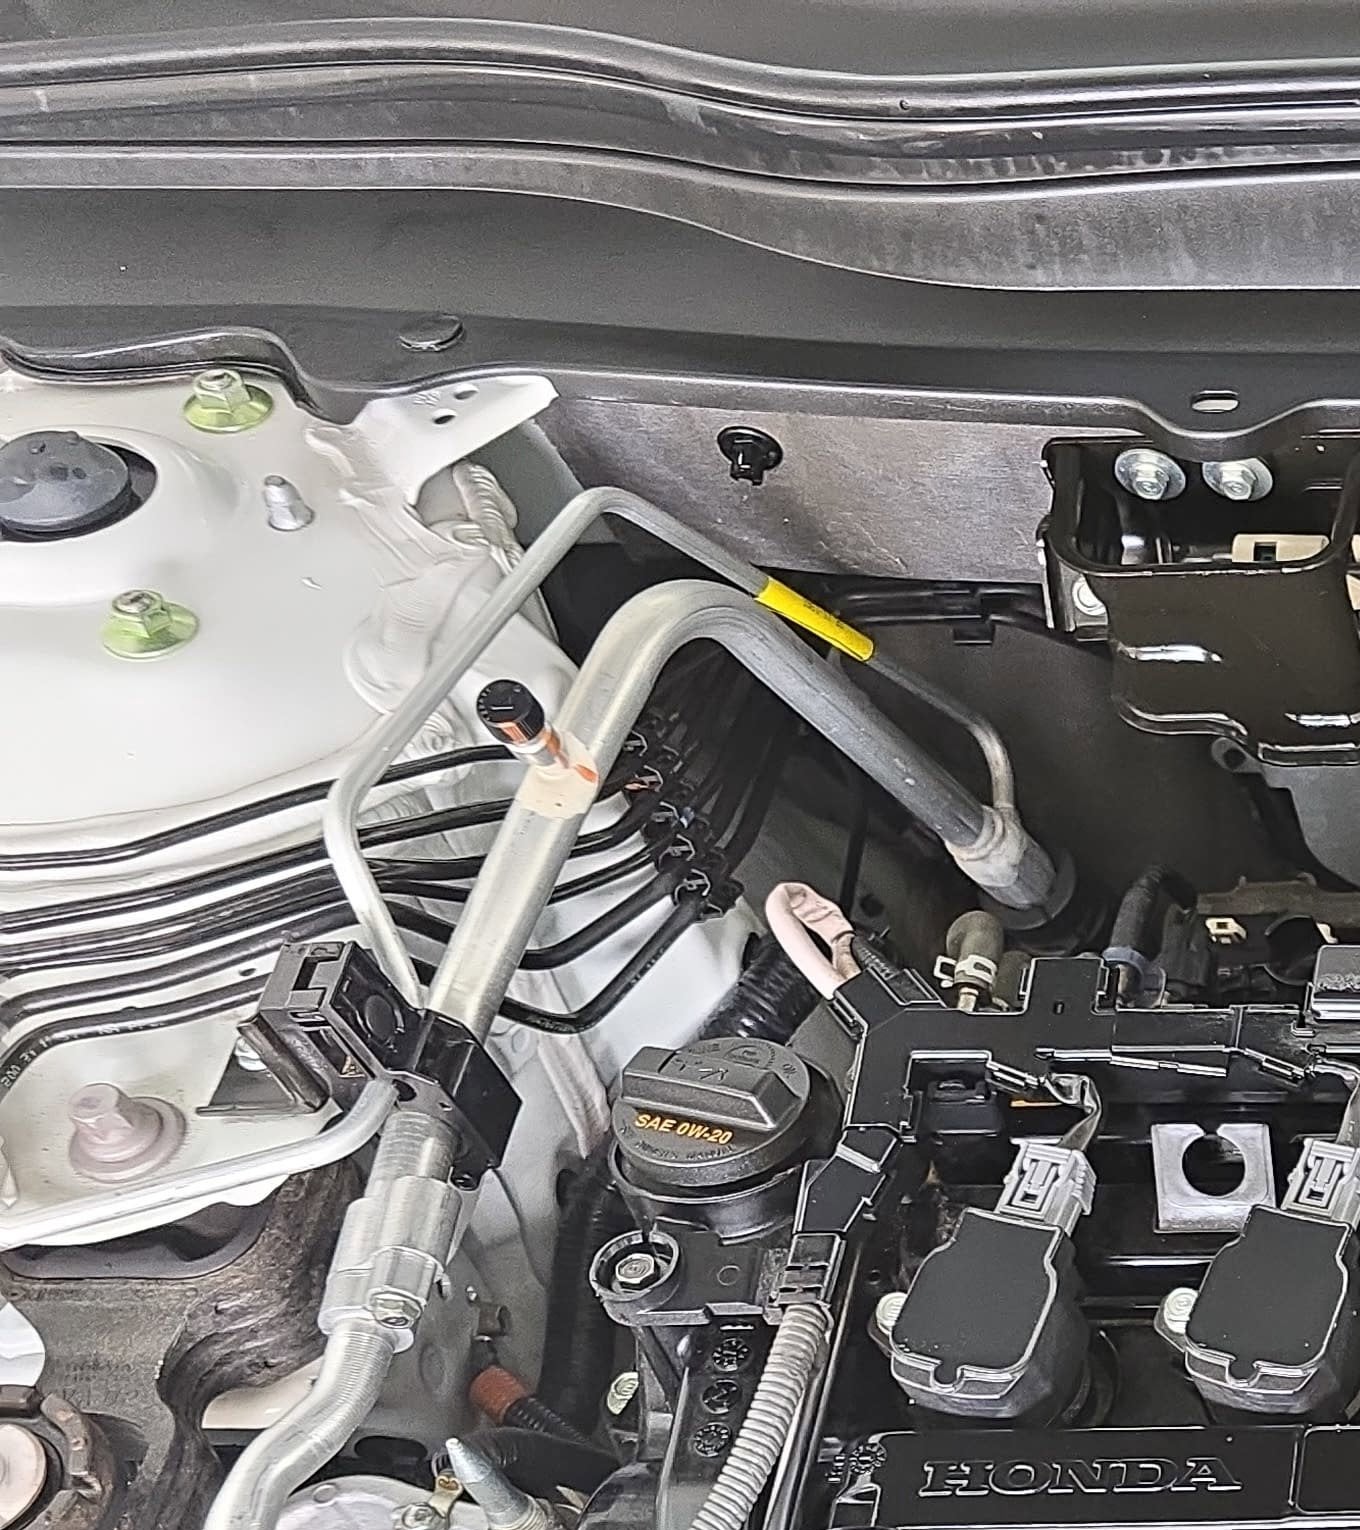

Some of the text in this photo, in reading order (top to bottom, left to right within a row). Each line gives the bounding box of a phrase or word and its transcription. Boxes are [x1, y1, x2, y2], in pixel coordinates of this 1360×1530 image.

[635, 1114, 734, 1145] SAE 0W-20
[918, 1456, 1242, 1498] HONDA
